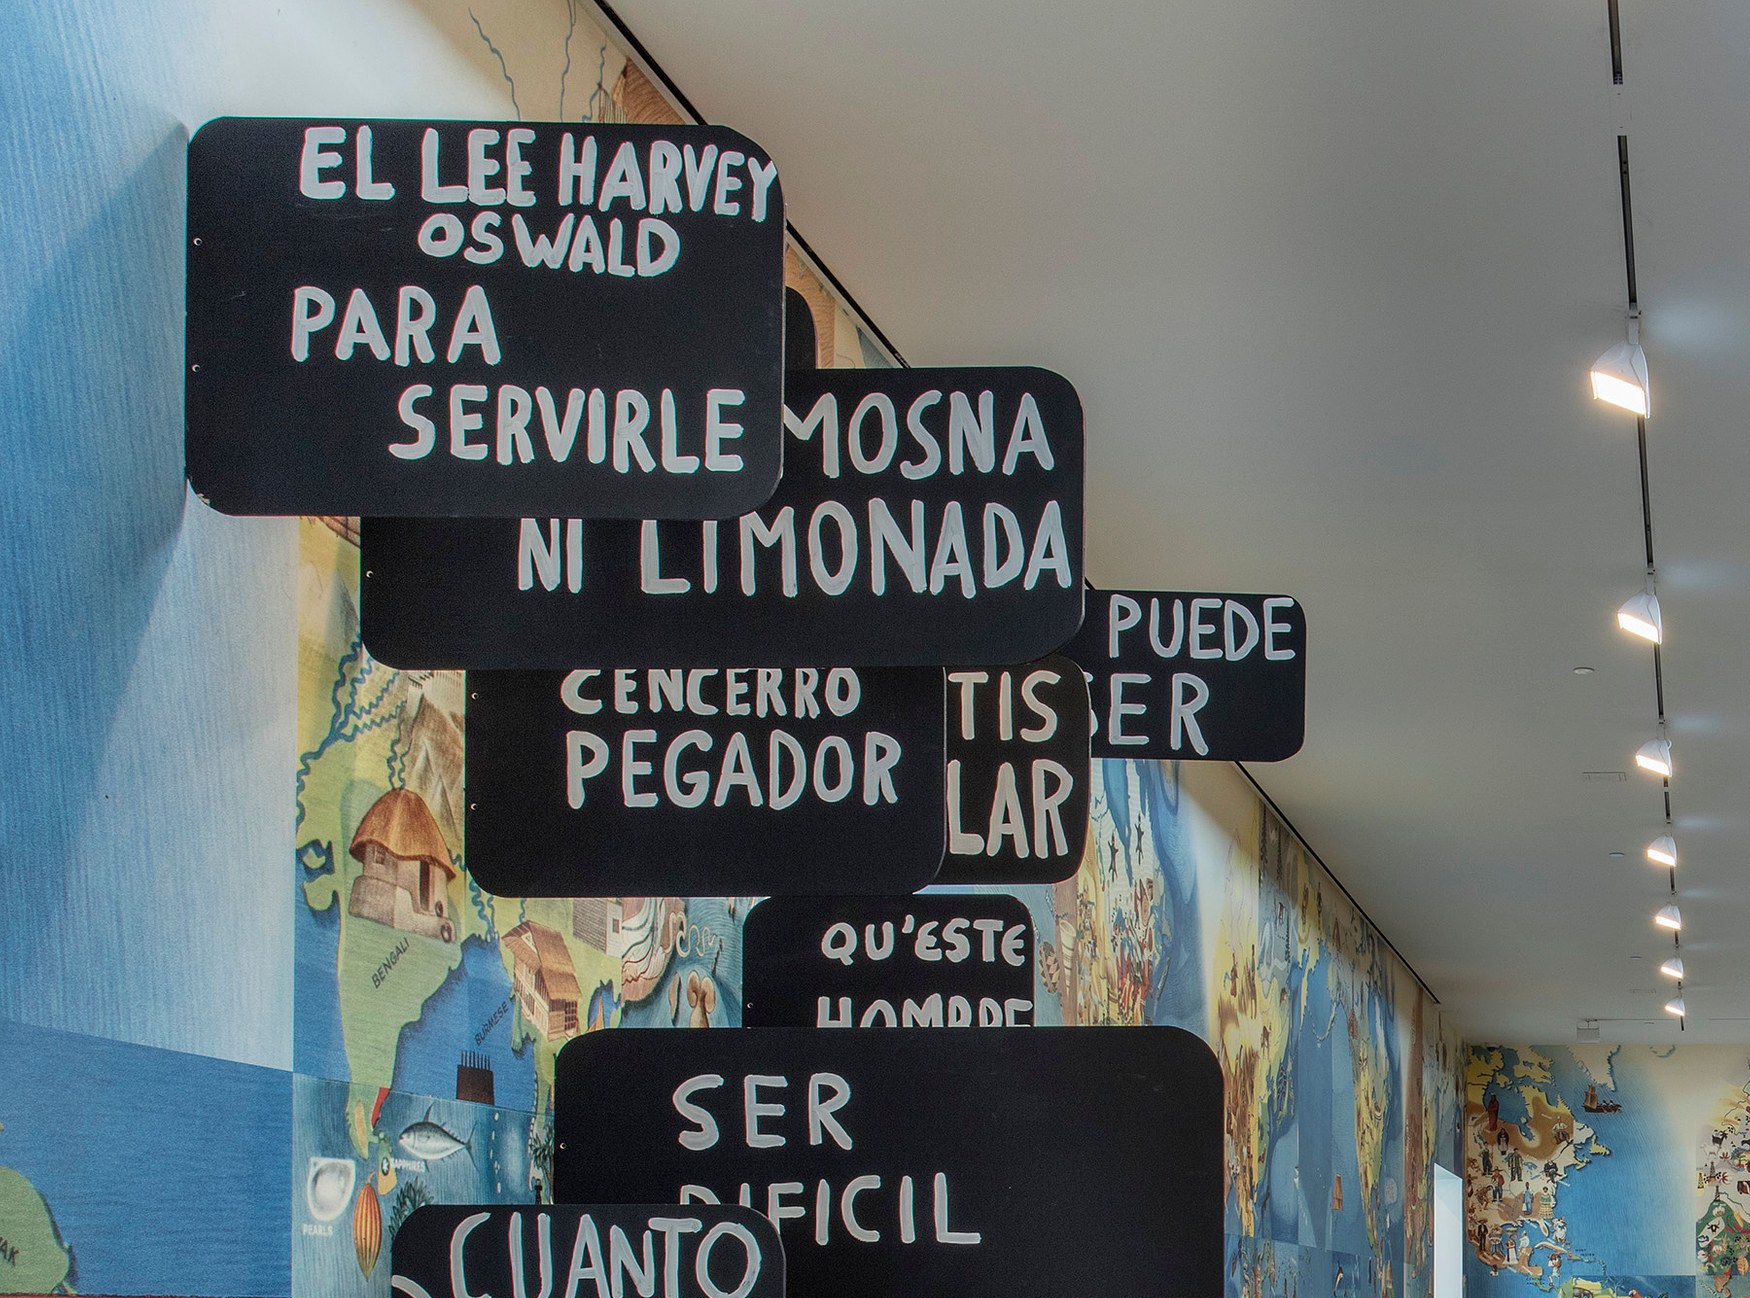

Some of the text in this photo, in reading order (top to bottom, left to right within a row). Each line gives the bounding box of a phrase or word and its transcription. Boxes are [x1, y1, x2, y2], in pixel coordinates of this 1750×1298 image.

[299, 124, 778, 223] EL LEE HARVEY
[417, 210, 682, 278] OSWALD
[290, 284, 502, 368] PARA
[387, 383, 746, 475] SERVIRLE
[517, 497, 1073, 600] NI LIMONADA
[1108, 593, 1296, 662] PUEDE
[560, 669, 861, 720] CENCERRO
[947, 669, 1062, 743] TIS
[1091, 672, 1210, 757] ER
[565, 728, 902, 811] PEGADOR
[946, 758, 1074, 860] LAR
[371, 937, 411, 989] BENGALI
[474, 1000, 509, 1047] BURMESE
[672, 1072, 853, 1151] SER
[679, 1171, 983, 1246] FICIL
